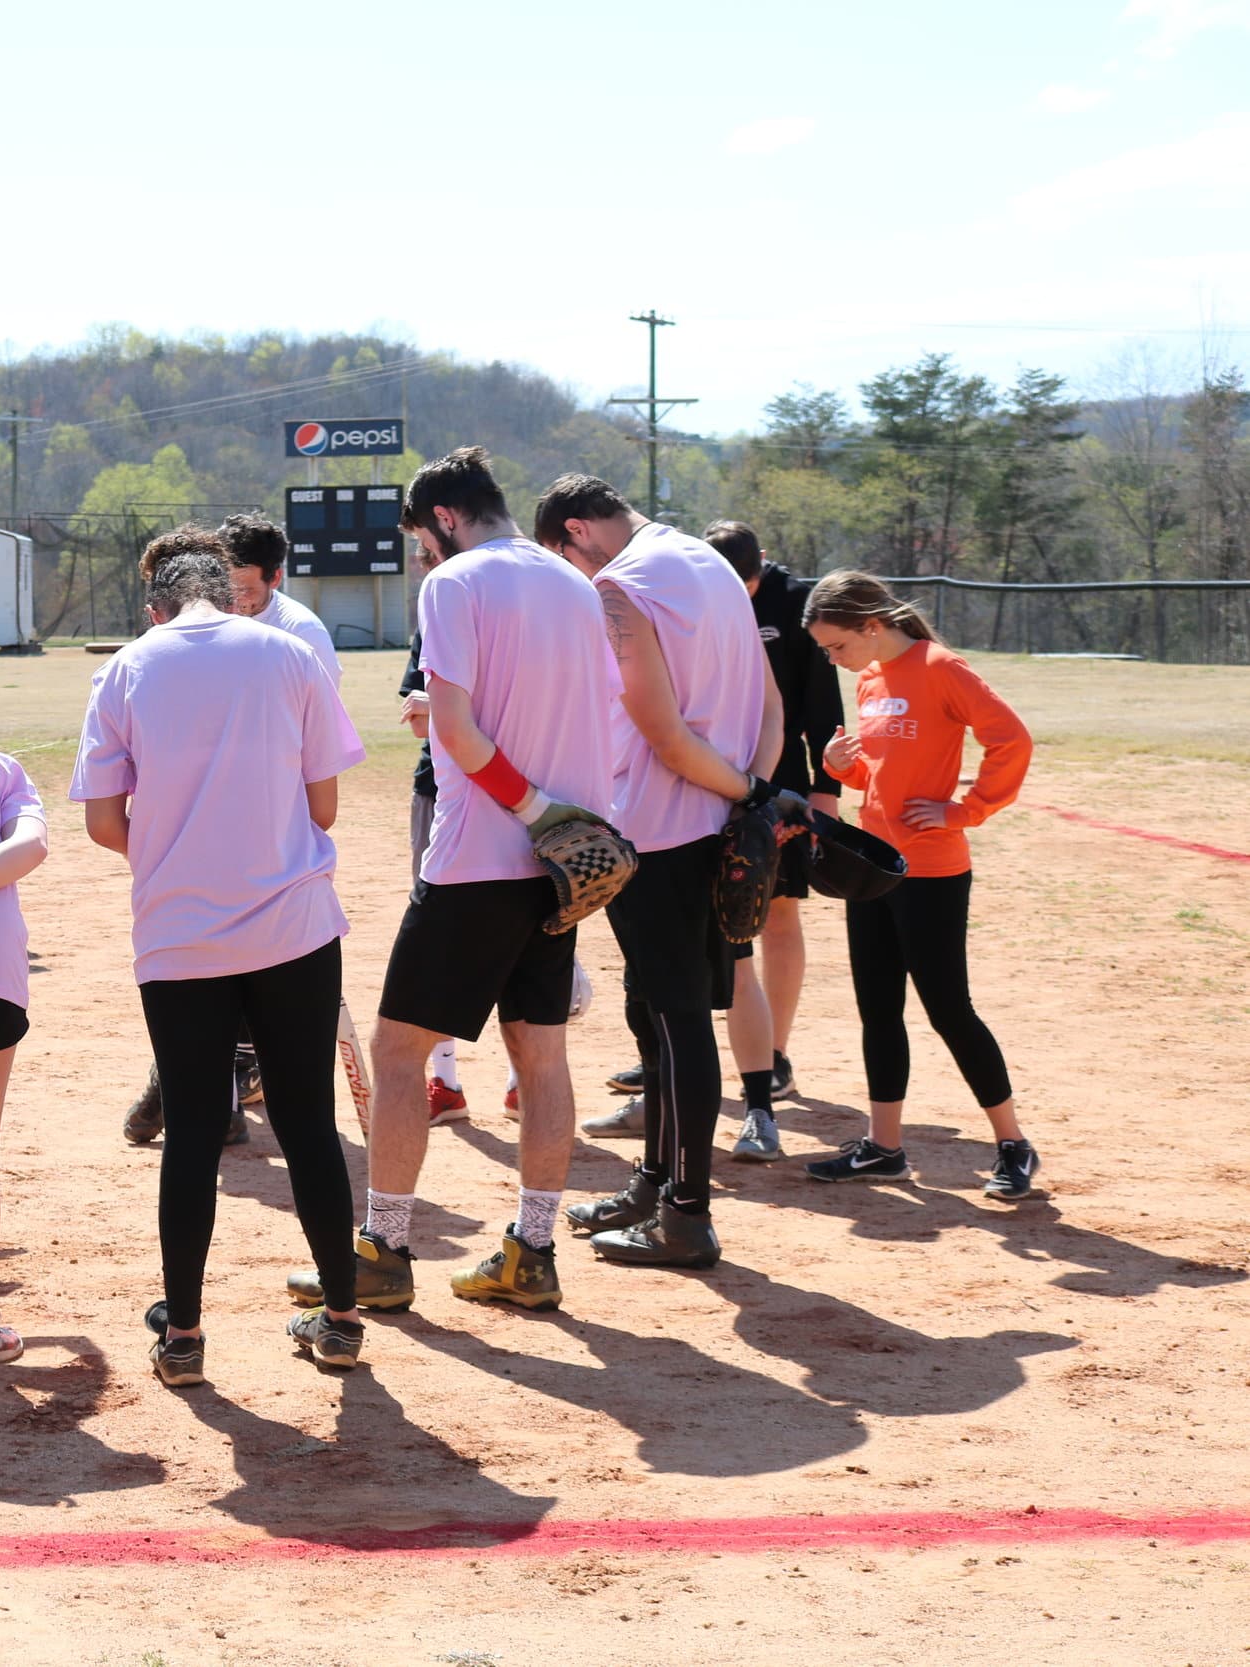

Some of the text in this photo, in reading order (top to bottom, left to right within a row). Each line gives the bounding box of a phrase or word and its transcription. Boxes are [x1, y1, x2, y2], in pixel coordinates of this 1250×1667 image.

[331, 426, 398, 449] pepsi
[291, 490, 324, 502] GUEST
[367, 489, 398, 501] HOME
[294, 544, 315, 553] BALL
[331, 542, 359, 552] STRIKE
[376, 541, 393, 550] OUT
[370, 562, 398, 572] ERROR
